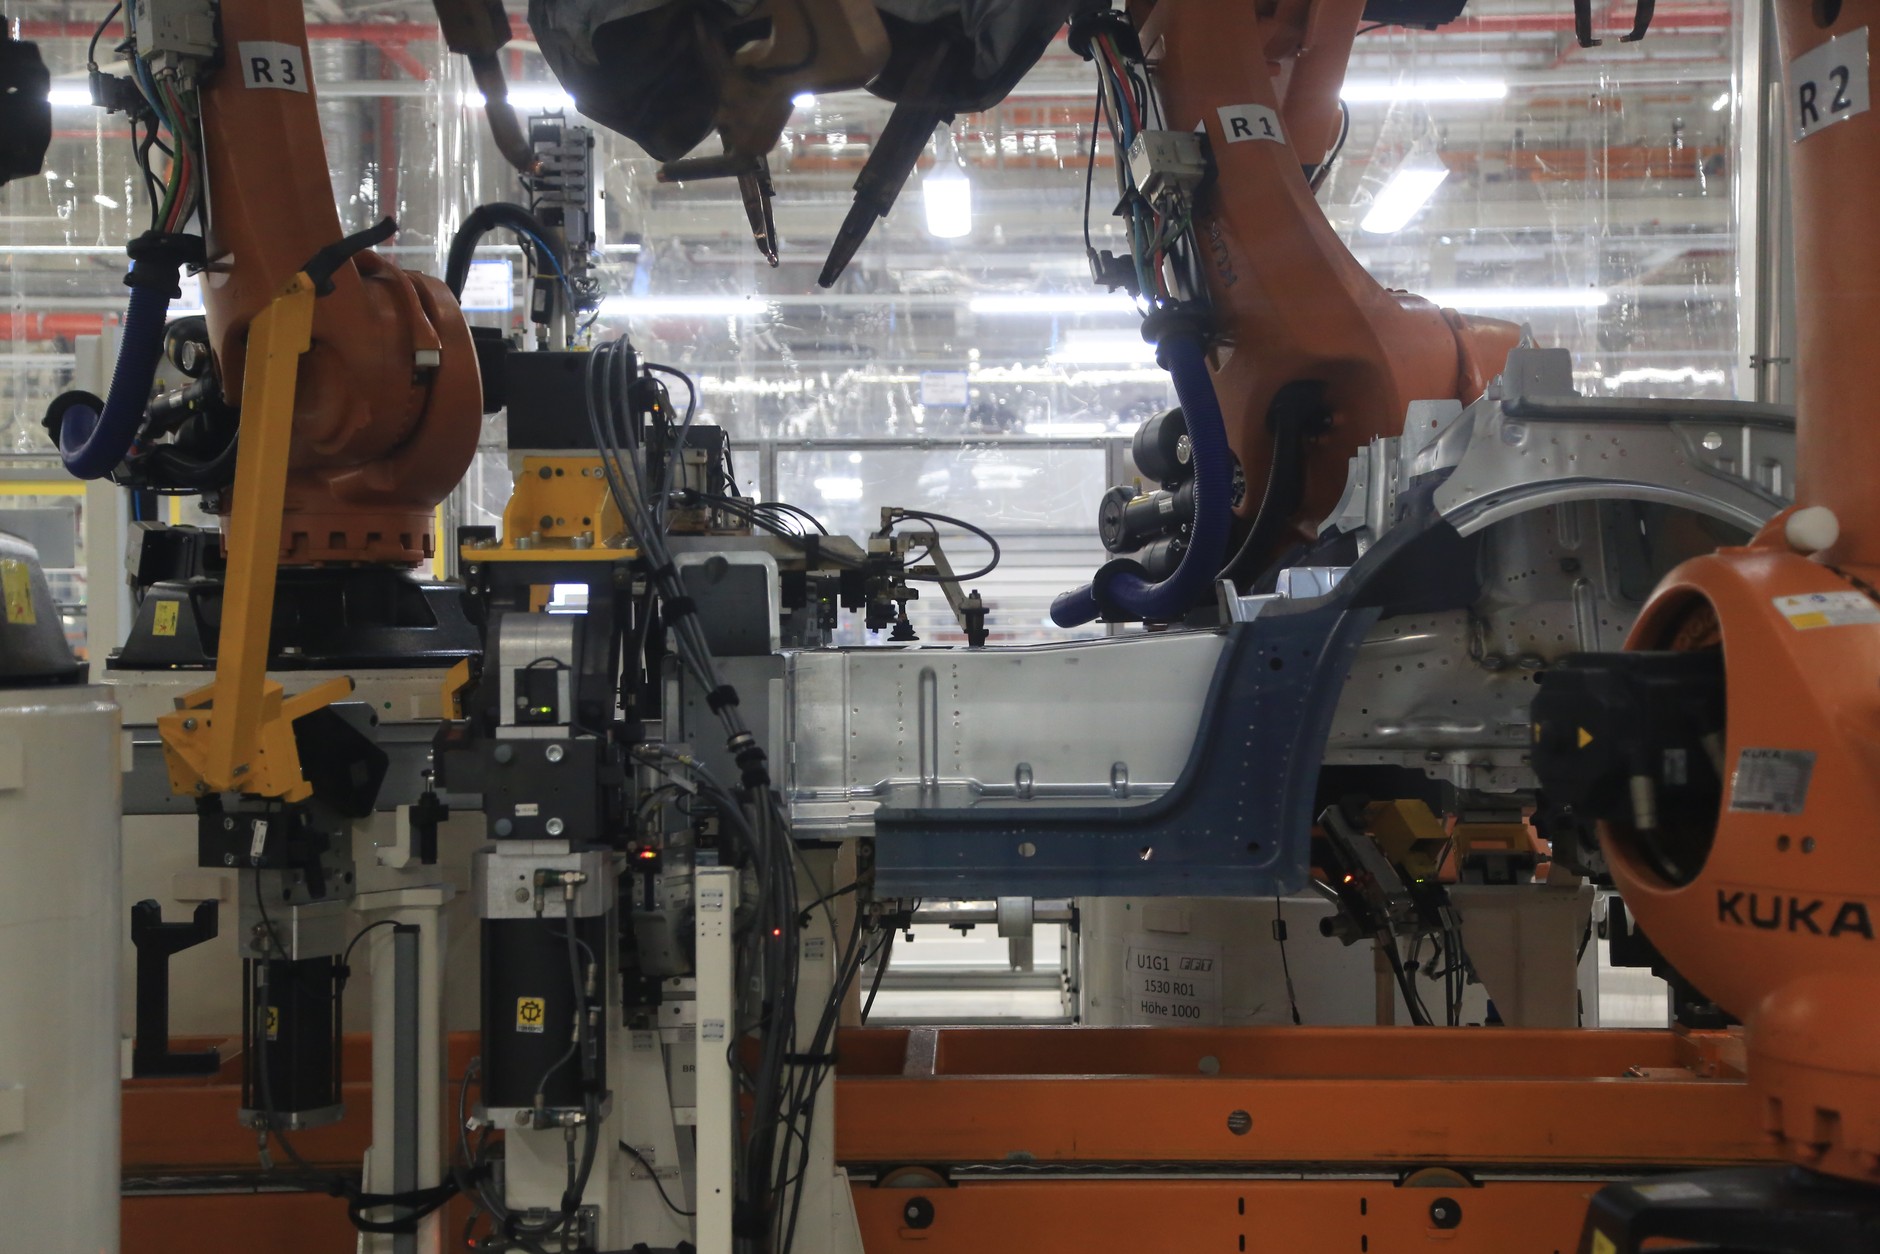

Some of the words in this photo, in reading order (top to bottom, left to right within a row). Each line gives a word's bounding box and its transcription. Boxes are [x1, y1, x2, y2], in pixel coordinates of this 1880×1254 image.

[1717, 889, 1875, 940] KUKA
[1137, 954, 1170, 972] U1G1
[1144, 979, 1171, 994] 1530
[1141, 1000, 1168, 1016] Höhe
[1171, 1004, 1200, 1019] 1000
